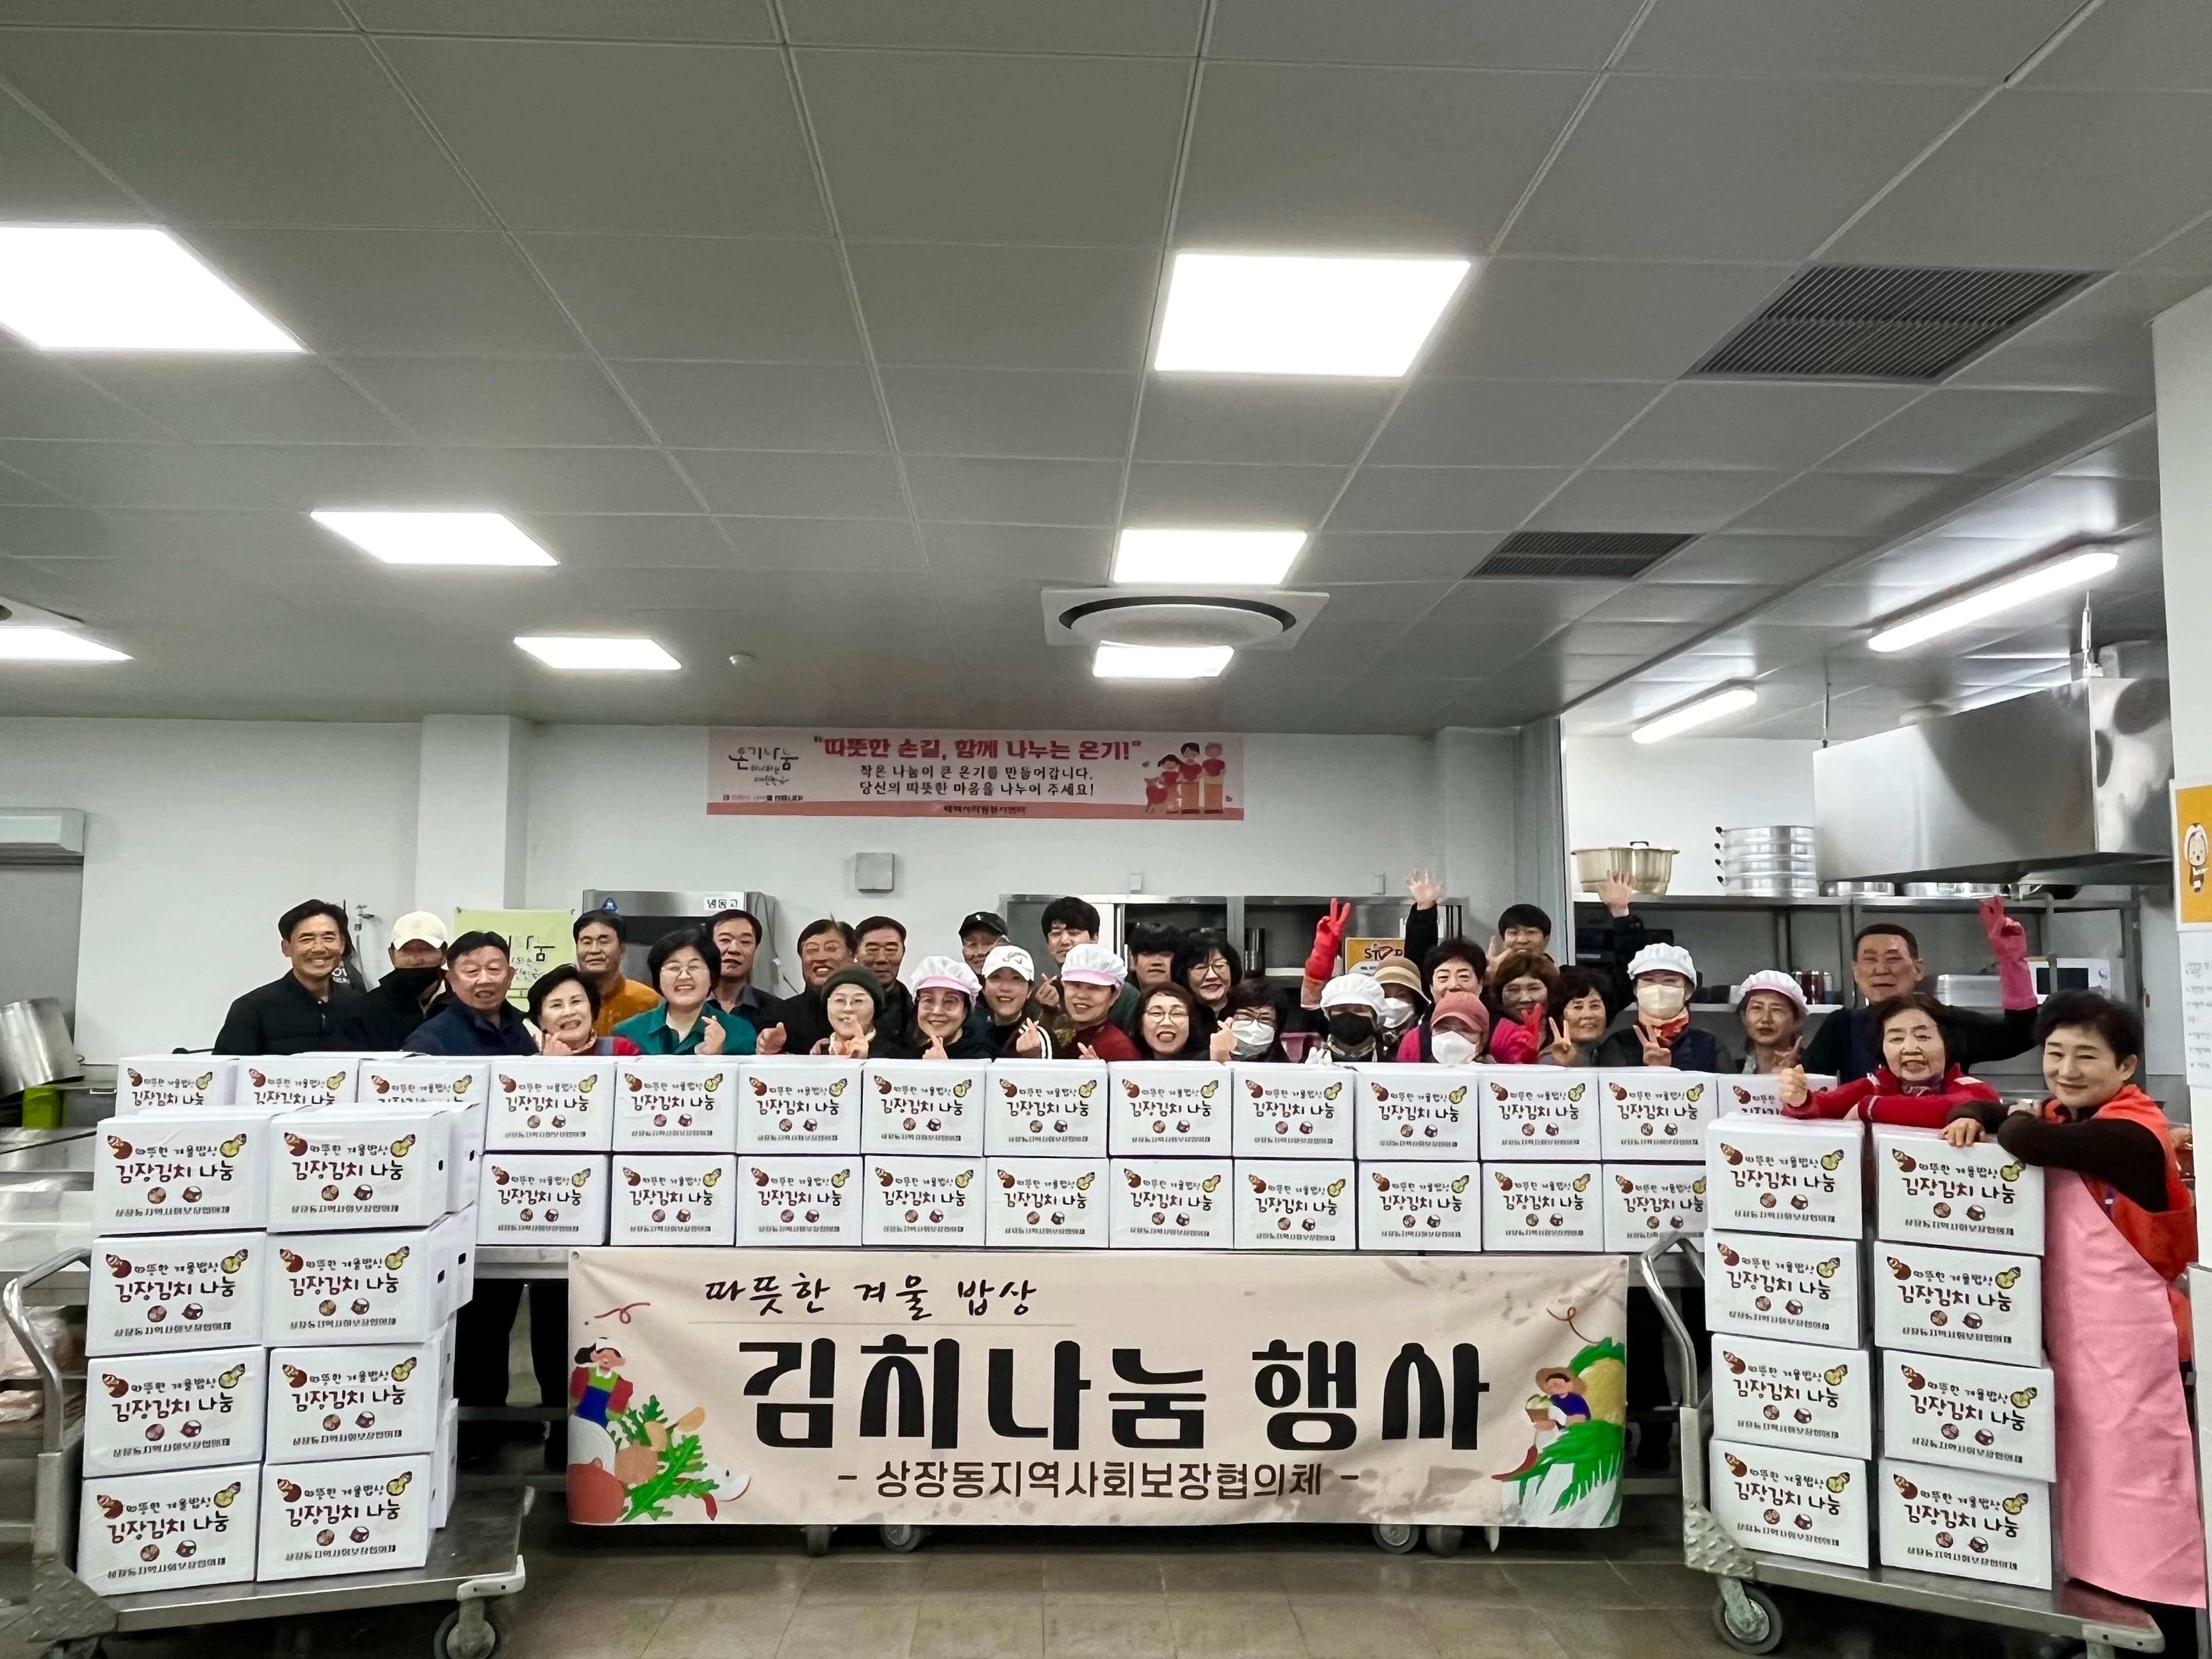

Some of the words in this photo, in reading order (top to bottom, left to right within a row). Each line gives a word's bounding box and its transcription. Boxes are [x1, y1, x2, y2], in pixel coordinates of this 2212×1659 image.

[898, 738, 946, 760] 손길,
[955, 739, 998, 758] 함께
[1006, 740, 1070, 760] 나누는
[861, 764, 886, 779] 작은
[893, 764, 933, 779] 나눔이
[959, 766, 998, 780] 온기
[860, 781, 900, 795] 당신의
[907, 782, 947, 796] 따뜻한
[1047, 783, 1094, 797] 주세요!
[505, 1096, 558, 1113] 김장김치
[564, 1094, 589, 1112] 나눔
[631, 1094, 684, 1111] 김장김치
[690, 1094, 715, 1111] 나눔
[756, 1099, 809, 1115] 김장김치
[815, 1099, 839, 1116] 나눔
[880, 1097, 934, 1115] 김장김치
[939, 1099, 963, 1116] 나눔
[1006, 1100, 1059, 1117] 김장김치
[1065, 1100, 1089, 1117] 나눔
[1129, 1100, 1182, 1118] 김장김치
[1187, 1100, 1212, 1117] 나눔
[1252, 1101, 1305, 1118] 김장김치
[1310, 1102, 1335, 1119] 나눔
[1498, 1104, 1550, 1120] 김장김치
[1555, 1103, 1580, 1120] 나눔
[1617, 1103, 1669, 1120] 김장김치
[1674, 1103, 1698, 1120] 나눔
[1378, 1104, 1430, 1121] 김장김치
[1435, 1105, 1459, 1123] 나눔
[115, 1162, 191, 1184] 김장김치
[199, 1160, 234, 1181] 나눔
[291, 1160, 363, 1181] 김장김치
[370, 1159, 404, 1181] 나눔
[1730, 1169, 1797, 1190] 김장김치
[1804, 1173, 1836, 1193] 나눔
[1901, 1177, 1974, 1199] 김장김치
[1981, 1183, 2016, 1205] 나눔
[497, 1188, 551, 1205] 김장김치
[556, 1188, 582, 1206] 나눔
[629, 1189, 683, 1206] 김장김치
[688, 1189, 713, 1206] 나눔
[757, 1190, 812, 1207] 김장김치
[817, 1190, 842, 1207] 나눔
[882, 1190, 935, 1207] 김장김치
[941, 1190, 966, 1207] 나눔
[1003, 1191, 1057, 1209] 김장김치
[1062, 1192, 1088, 1209] 나눔
[1130, 1191, 1183, 1209] 김장김치
[1188, 1194, 1213, 1211] 나눔
[1255, 1196, 1308, 1214] 김장김치
[1313, 1198, 1338, 1216] 나눔
[1379, 1195, 1433, 1211] 김장김치
[1437, 1195, 1463, 1212] 나눔
[1502, 1194, 1555, 1210] 김장김치
[1559, 1193, 1584, 1211] 나눔
[1623, 1196, 1675, 1213] 김장김치
[115, 1281, 192, 1303] 김장김치
[200, 1275, 236, 1298] 나눔
[289, 1275, 359, 1297] 김장김치
[366, 1272, 399, 1294] 나눔
[1726, 1271, 1792, 1293] 김장김치
[1799, 1279, 1831, 1300] 나눔
[705, 1272, 831, 1316] 따뜻한
[853, 1275, 932, 1321] 겨울
[957, 1279, 1037, 1316] 밥상
[1897, 1285, 1970, 1307] 김장김치
[1977, 1290, 2012, 1312] 나눔
[291, 1389, 365, 1412] 김장김치
[372, 1384, 406, 1406] 나눔
[739, 1334, 1207, 1450] 김치나눔
[1252, 1339, 1490, 1451] 행사
[1733, 1378, 1800, 1402] 김장김치
[1807, 1387, 1839, 1408] 나눔
[111, 1398, 190, 1423] 김장김치
[198, 1391, 234, 1414] 나눔
[1910, 1394, 1983, 1421] 김장김치
[1991, 1409, 2025, 1432] 나눔
[876, 1461, 1322, 1501] 상장동지역사회보장협의체
[1734, 1481, 1801, 1506] 김장김치
[1808, 1494, 1841, 1516] 나눔
[285, 1504, 359, 1528] 김장김치
[366, 1498, 401, 1520] 나눔
[1903, 1504, 1976, 1529] 김장김치
[1984, 1516, 2019, 1538] 나눔
[106, 1518, 185, 1544] 김장김치
[193, 1510, 230, 1532] 나눔
